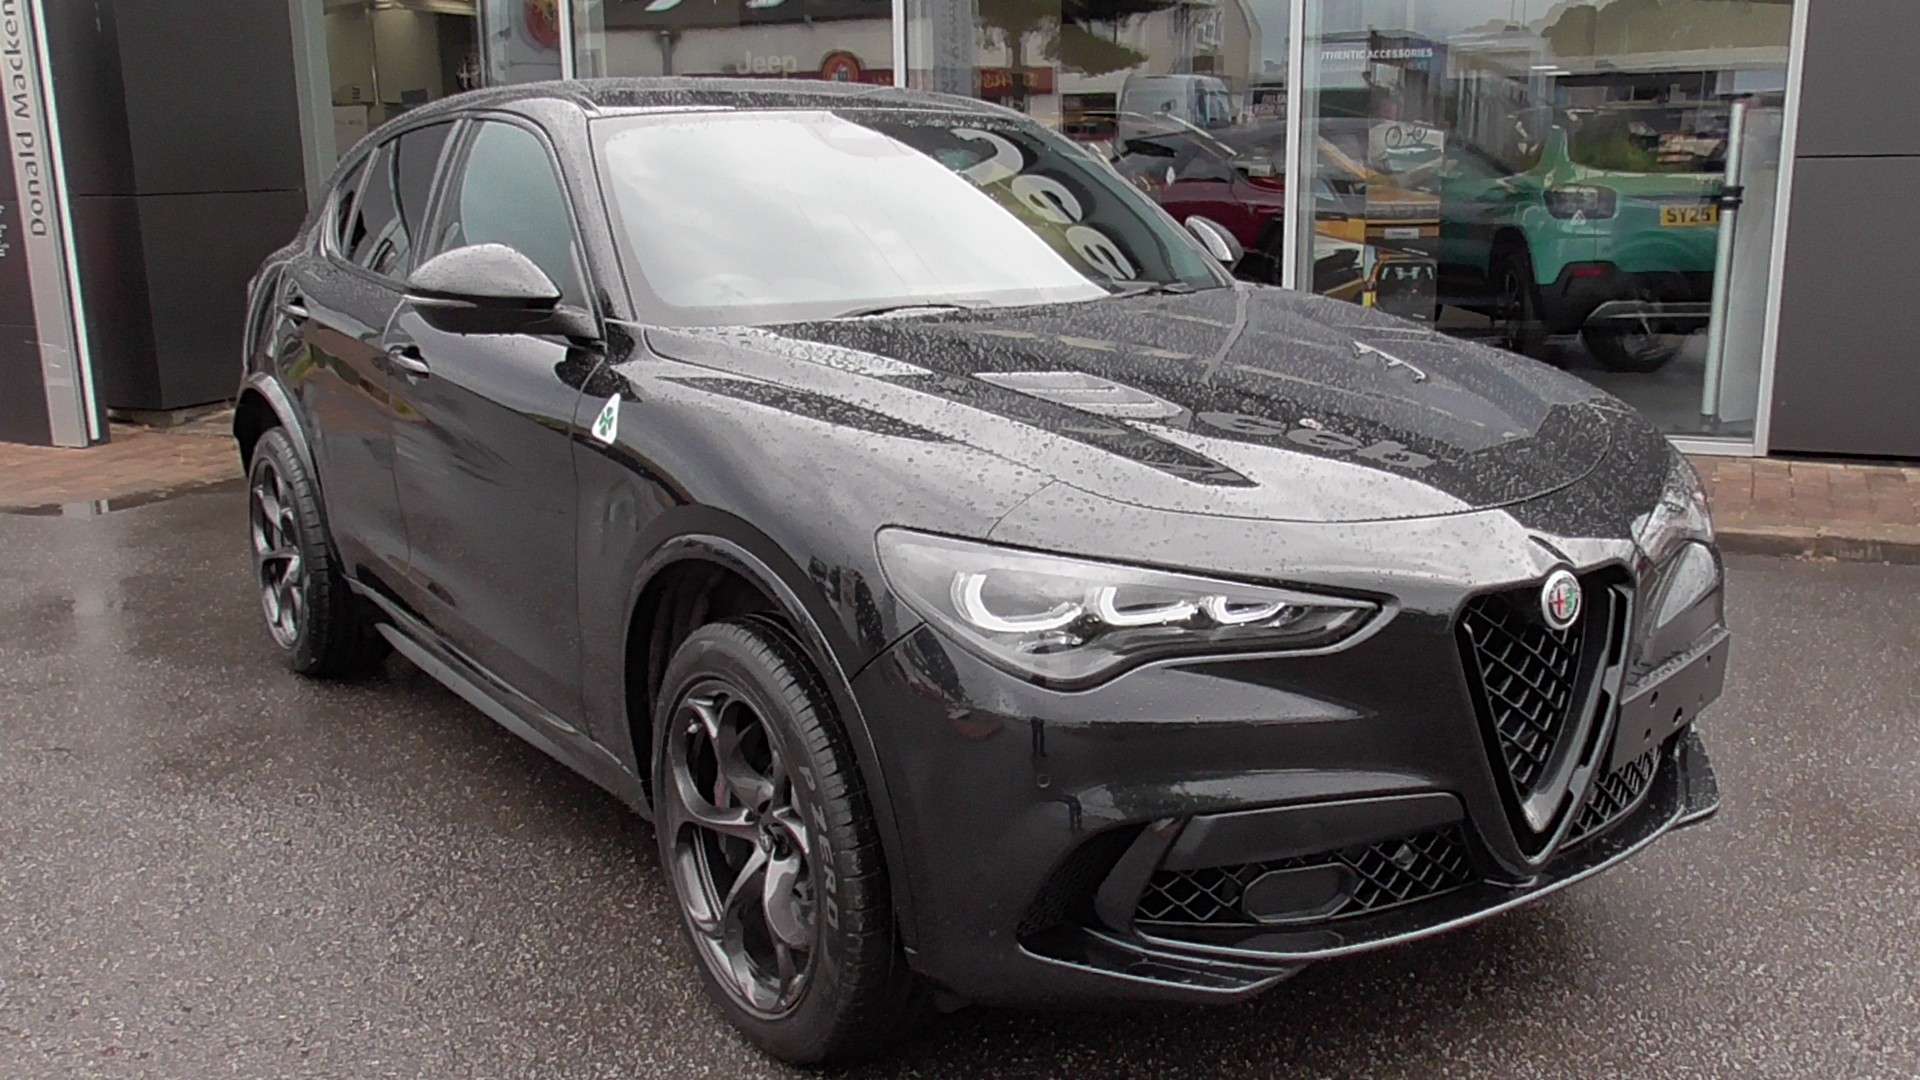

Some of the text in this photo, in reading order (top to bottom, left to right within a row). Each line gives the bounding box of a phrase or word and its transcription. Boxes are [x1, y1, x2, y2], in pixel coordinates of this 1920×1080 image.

[736, 50, 798, 79] Jeep
[1367, 47, 1433, 59] ACCESSORIES
[1, 0, 48, 237] Donald Macken
[1666, 207, 1711, 223] SY25
[798, 765, 840, 931] P ZERO
